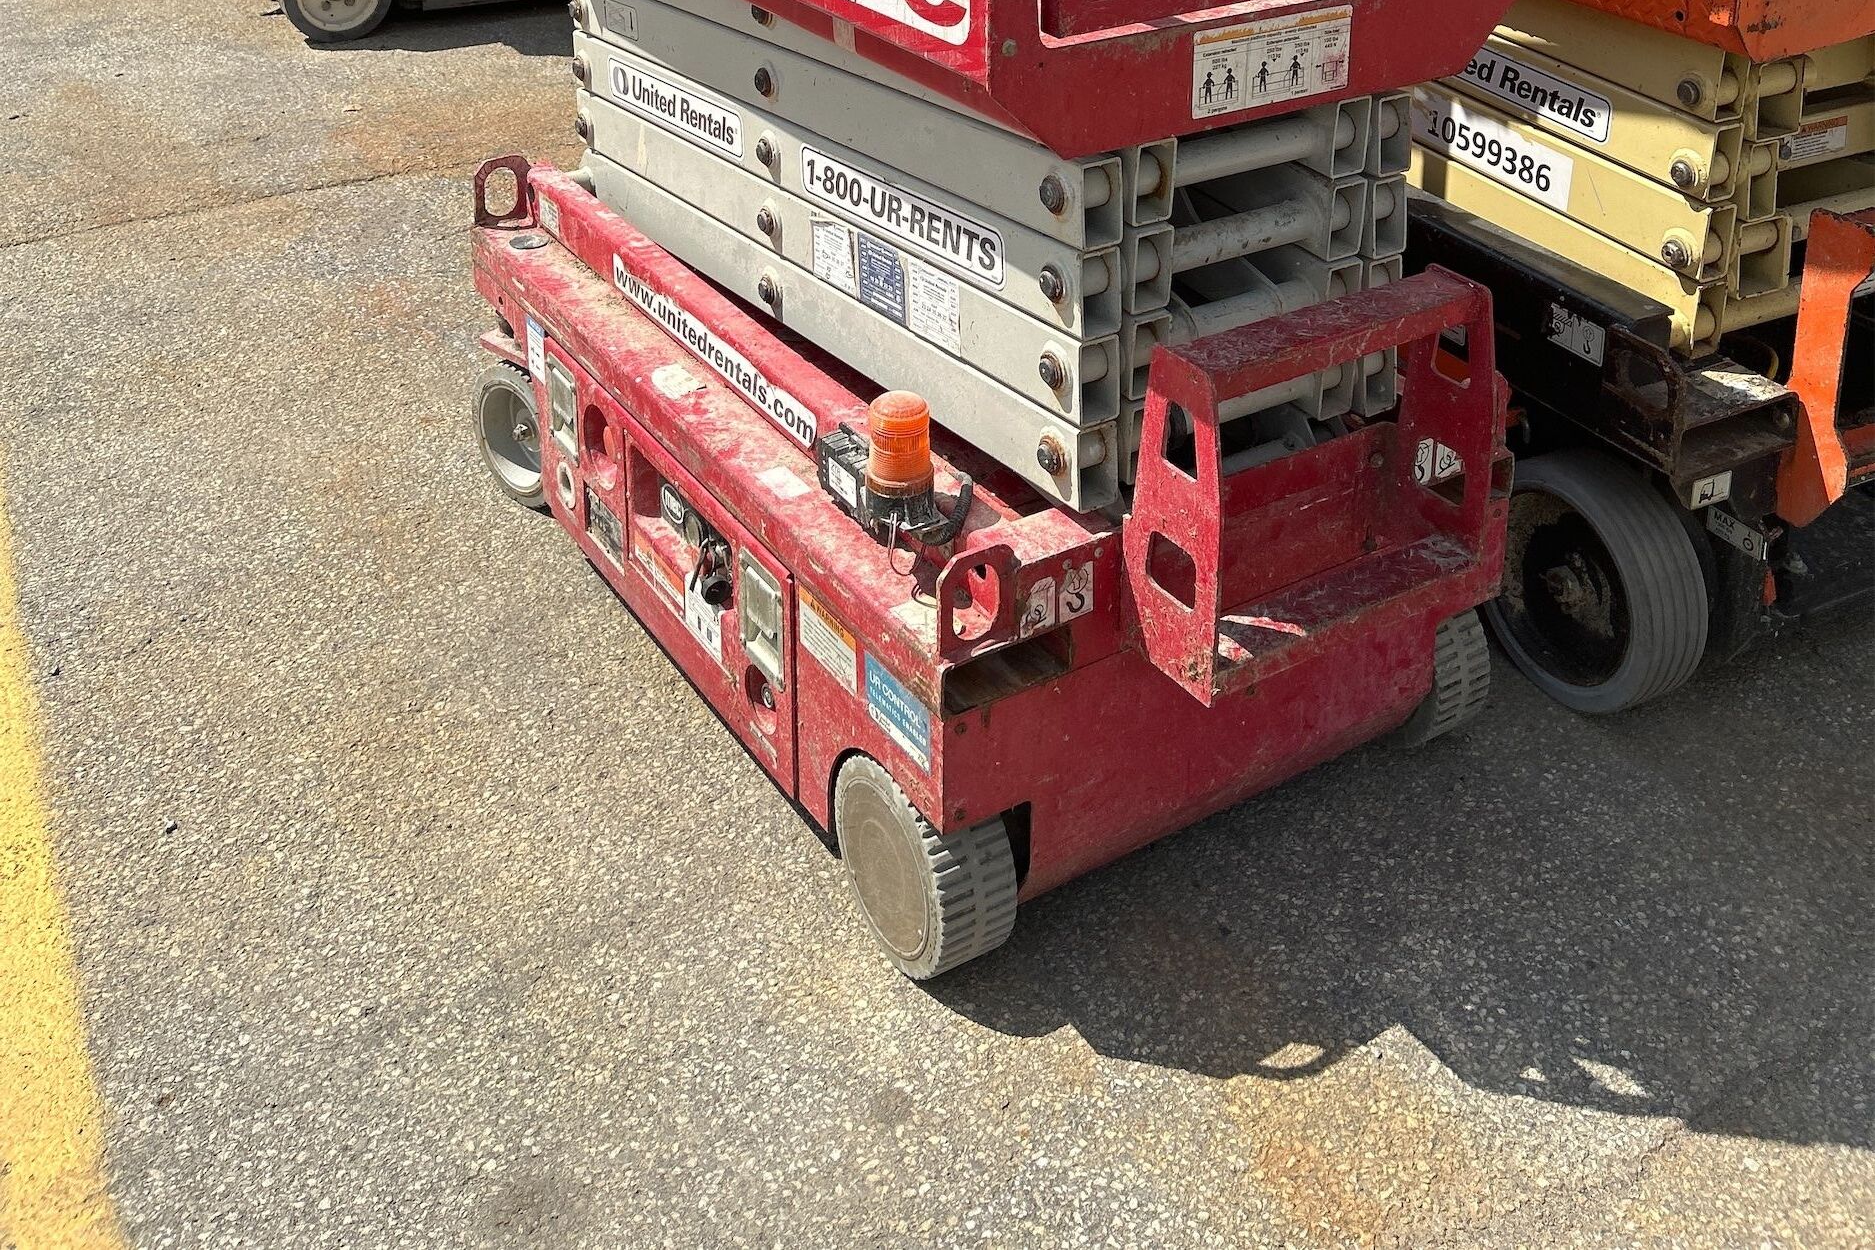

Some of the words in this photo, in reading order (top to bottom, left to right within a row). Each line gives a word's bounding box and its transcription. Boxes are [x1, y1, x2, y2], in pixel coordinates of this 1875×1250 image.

[632, 75, 676, 118] United
[680, 97, 734, 145] Rentals
[1499, 64, 1597, 128] Rentals
[1427, 110, 1551, 192] 10599386
[806, 158, 997, 271] 1-800-UR-RENTS
[615, 266, 814, 444] www.unitedrentals.com
[1714, 512, 1735, 530] MAX
[816, 602, 845, 639] WARNING
[869, 669, 881, 690] UR
[881, 681, 921, 729] CONTROL
